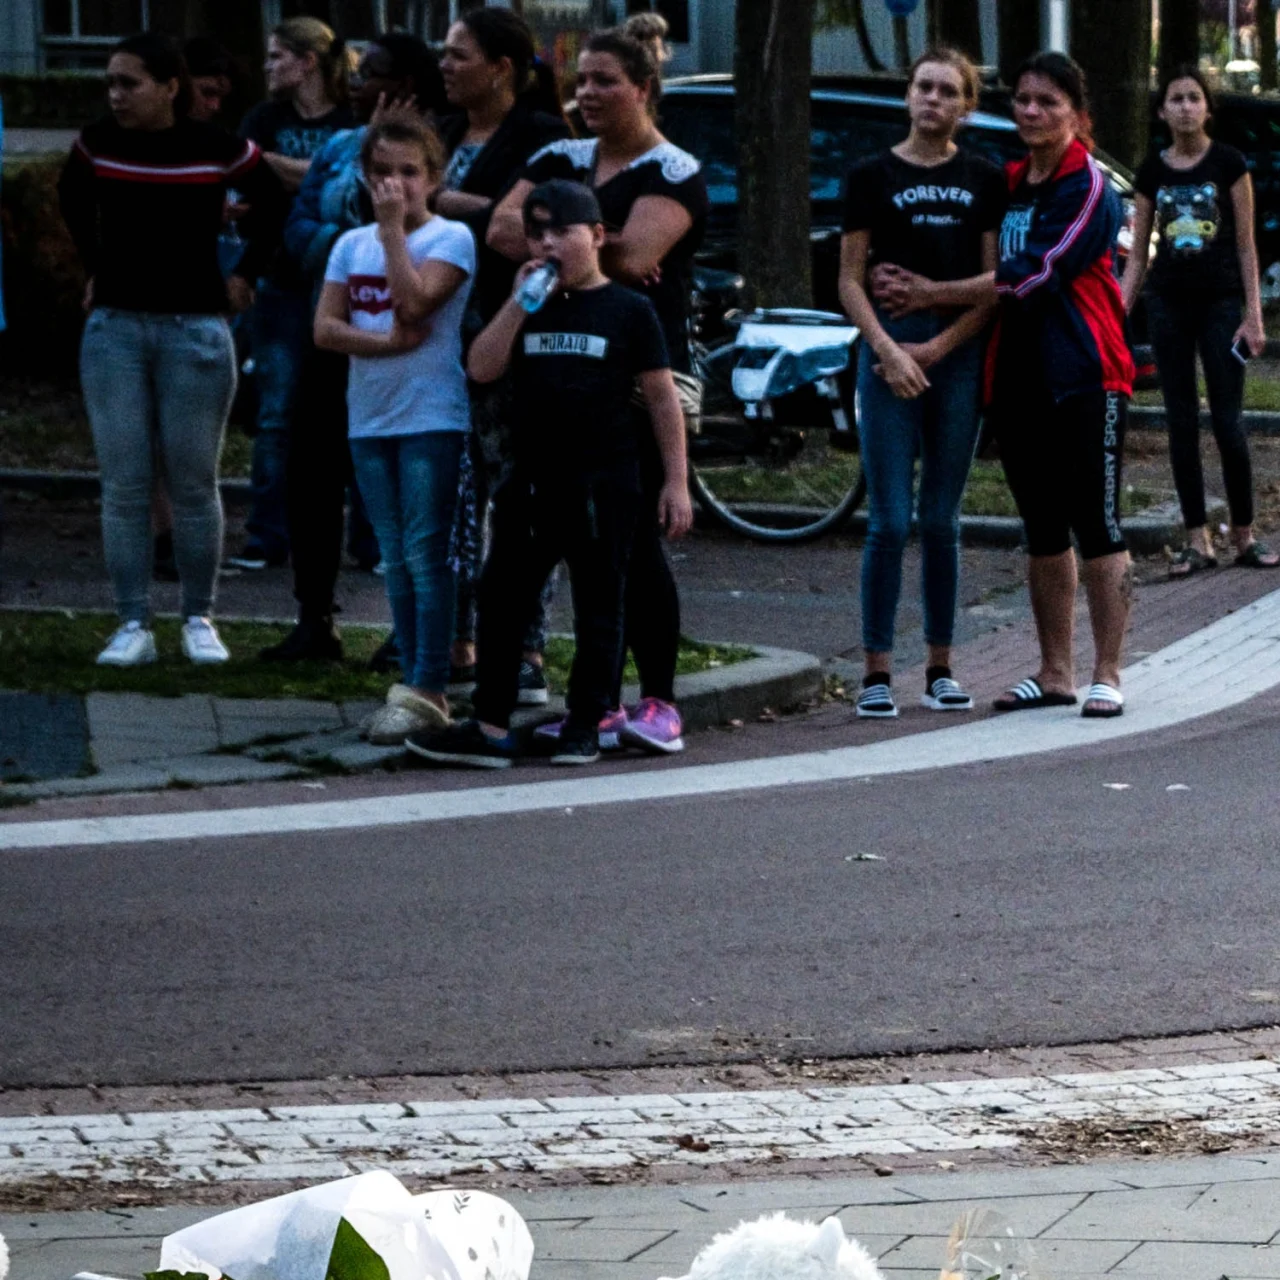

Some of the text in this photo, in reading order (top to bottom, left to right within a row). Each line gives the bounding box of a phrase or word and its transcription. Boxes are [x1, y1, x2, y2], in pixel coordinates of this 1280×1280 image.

[892, 184, 974, 210] FOREVER
[349, 285, 392, 303] Lev
[539, 334, 589, 353] MORATO
[1104, 452, 1122, 543] SUPERDRY
